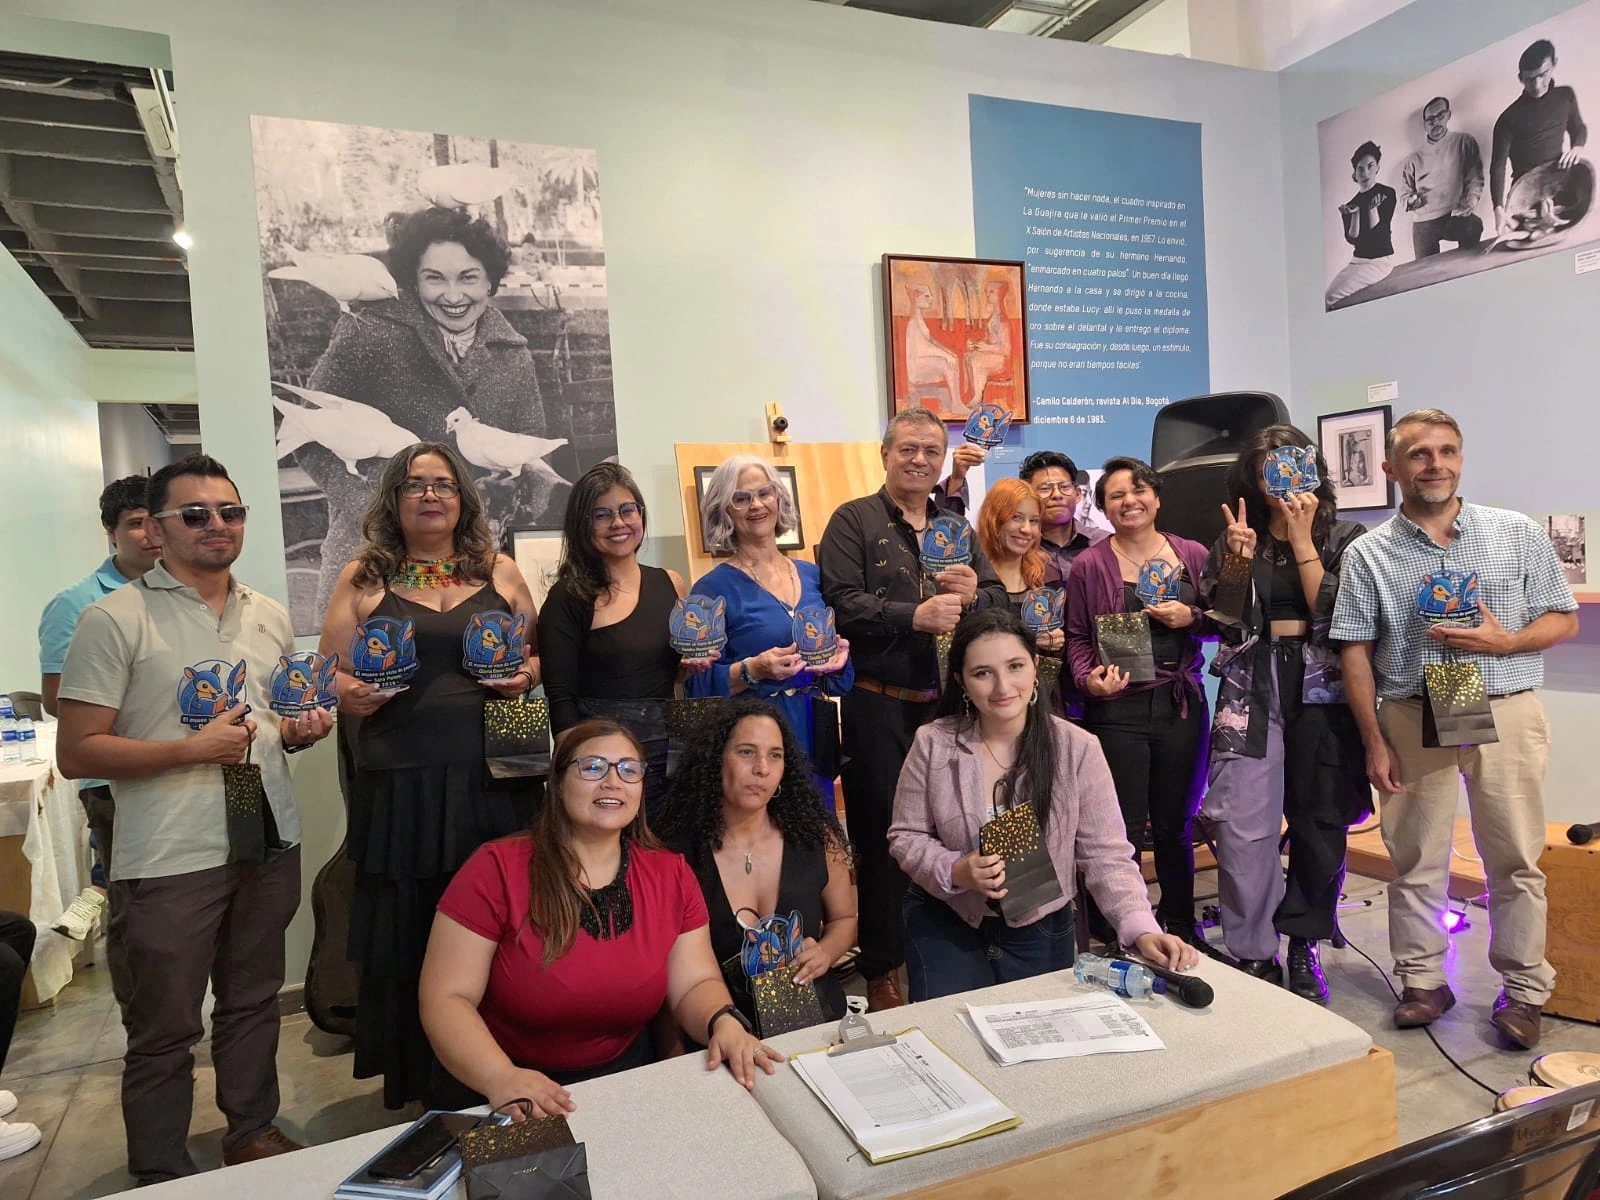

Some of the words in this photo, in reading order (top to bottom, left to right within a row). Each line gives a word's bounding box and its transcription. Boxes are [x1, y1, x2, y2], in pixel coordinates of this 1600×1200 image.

[1070, 192, 1090, 201] hacer
[1092, 195, 1112, 204] nada,
[1114, 196, 1119, 204] el
[1121, 197, 1145, 206] cuadro
[1146, 200, 1176, 209] inspirado
[1023, 206, 1033, 216] La
[1035, 208, 1062, 218] Guajira
[1064, 211, 1078, 221] que
[1080, 211, 1088, 220] le
[1110, 214, 1117, 222] el
[1119, 214, 1141, 224] Primer
[1144, 216, 1167, 226] Premio
[1180, 220, 1186, 228] el
[1026, 226, 1031, 234] X
[1032, 226, 1052, 236] Salón
[1053, 228, 1062, 236] de
[1063, 229, 1090, 239] Artistas
[1091, 230, 1129, 241] Nacionales,
[1158, 236, 1165, 244] Lo
[1027, 246, 1039, 255] por
[1044, 247, 1085, 257] sugerencia
[1091, 249, 1100, 257] de
[1120, 251, 1149, 261] hermano
[1154, 253, 1187, 264] Hernando,
[1083, 268, 1105, 277] cuatro
[1132, 270, 1141, 278] Un
[1143, 272, 1159, 280] buen
[1161, 272, 1171, 280] día
[1028, 284, 1063, 293] Hernando
[1075, 285, 1081, 294] la
[1105, 289, 1110, 297] y
[1156, 289, 1162, 297] la
[1028, 303, 1052, 311] donde
[1055, 304, 1079, 312] estaba
[1117, 306, 1123, 314] le
[1125, 307, 1142, 315] puso
[1145, 307, 1150, 315] la
[1153, 308, 1179, 316] medalla
[1182, 308, 1191, 317] de
[1044, 322, 1065, 330] sobre
[1078, 323, 1106, 332] delantal
[1109, 325, 1114, 334] y
[1116, 324, 1123, 332] le
[1154, 325, 1160, 334] el
[1030, 340, 1043, 348] Fue
[1055, 342, 1101, 352] consagración
[1102, 344, 1108, 352] y,
[1110, 343, 1130, 351] desde
[1031, 360, 1057, 369] porque
[1058, 360, 1068, 368] no
[1069, 360, 1085, 369] eran
[1087, 360, 1115, 371] tiempos
[1062, 397, 1095, 406] Calderón,
[1097, 397, 1120, 405] revista
[1122, 397, 1129, 405] Al
[1033, 415, 1068, 424] diciembre
[1076, 415, 1085, 424] de
